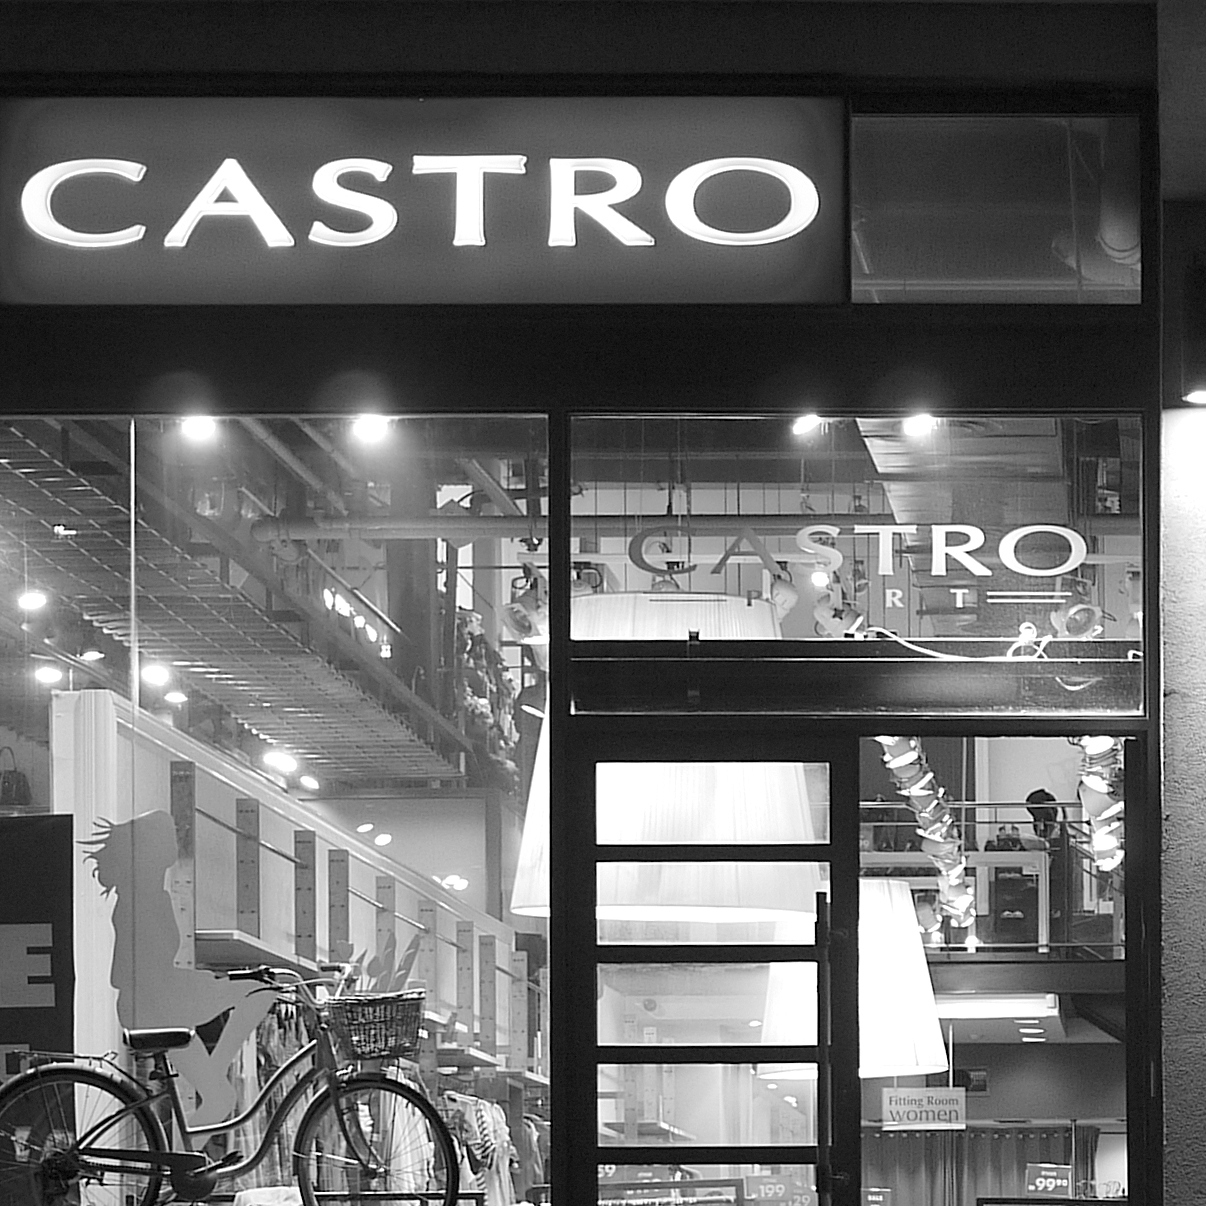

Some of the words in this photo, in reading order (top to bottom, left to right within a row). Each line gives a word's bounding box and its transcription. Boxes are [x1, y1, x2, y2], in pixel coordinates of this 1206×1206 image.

[20, 154, 821, 248] CASTRO
[628, 524, 1088, 577] CASTRO
[746, 588, 969, 608] PRT
[888, 1095, 924, 1108] Fitting
[927, 1095, 960, 1106] Room
[888, 1109, 960, 1123] women
[759, 1184, 786, 1198] 199
